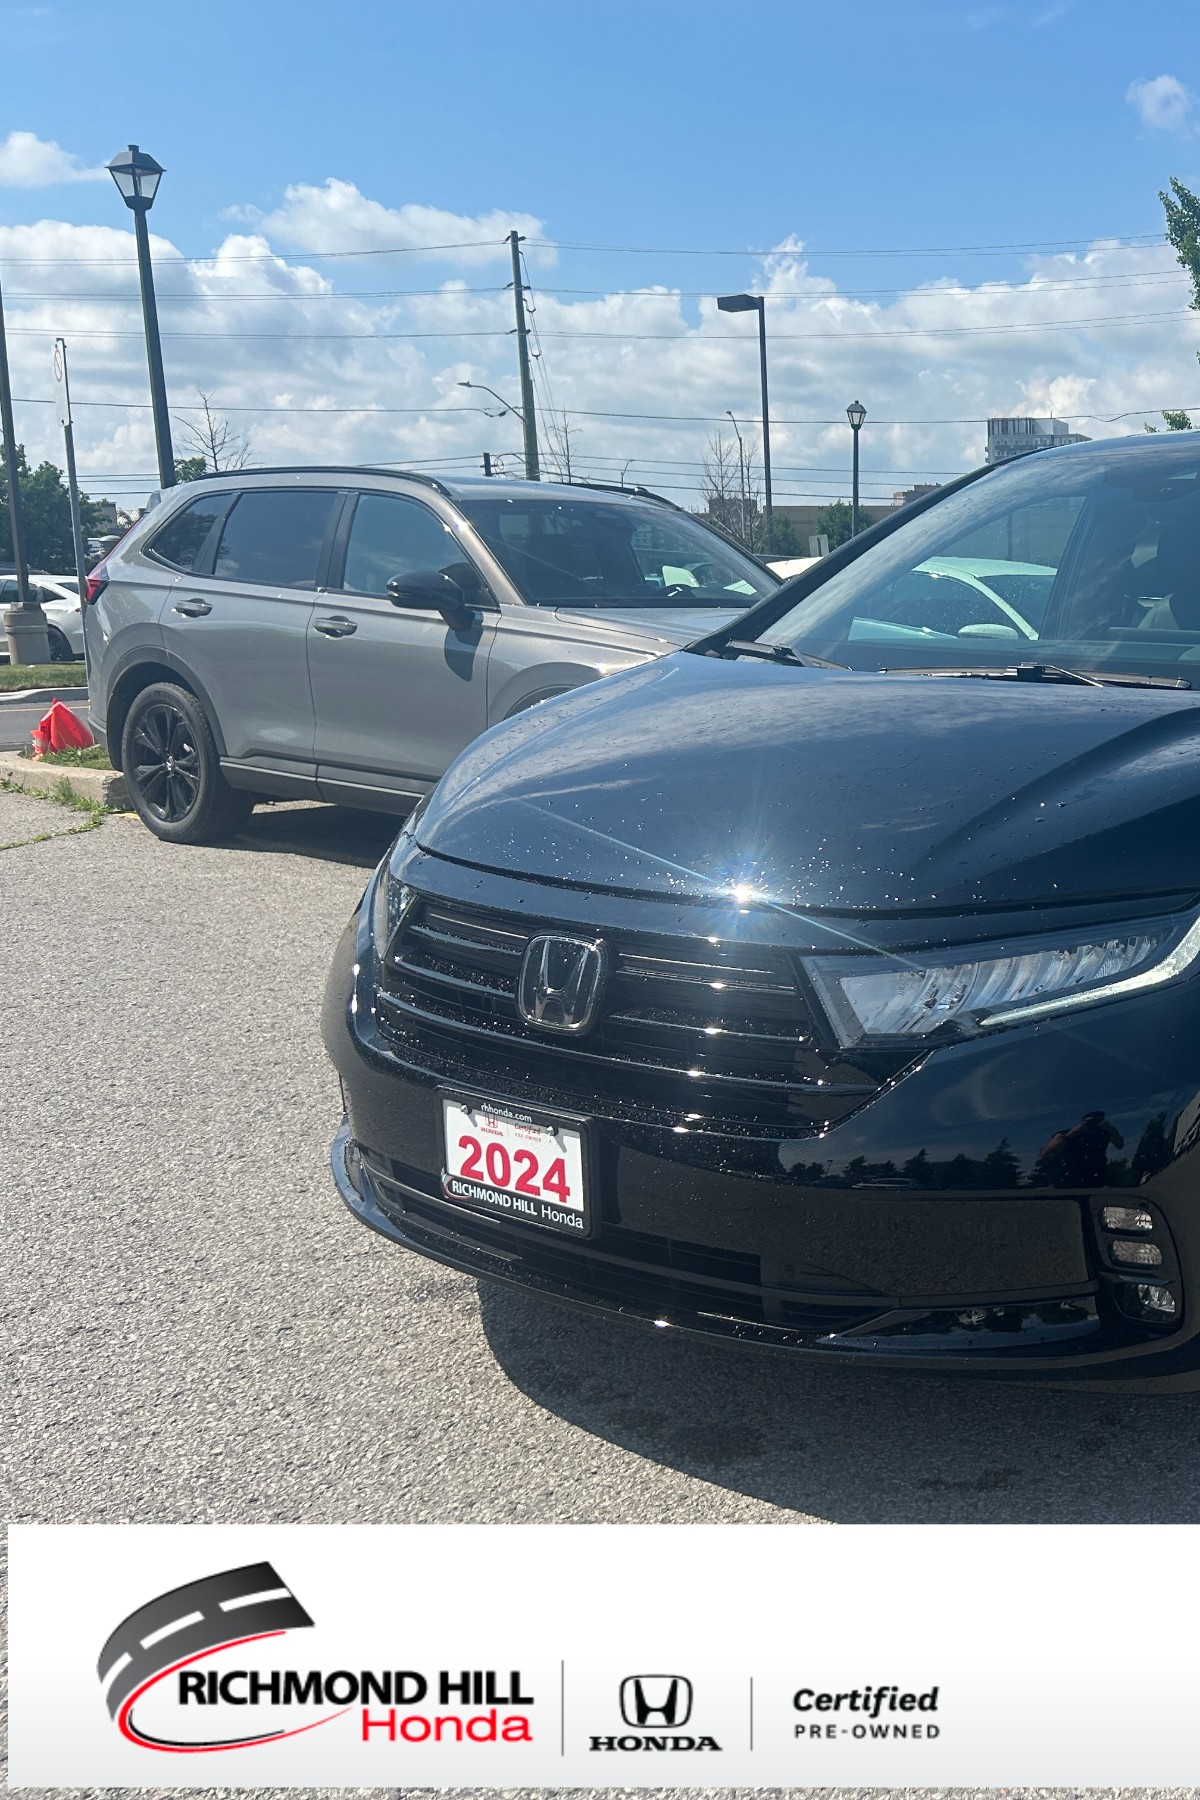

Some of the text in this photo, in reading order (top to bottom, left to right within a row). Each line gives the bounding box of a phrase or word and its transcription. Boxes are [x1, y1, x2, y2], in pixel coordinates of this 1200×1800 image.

[480, 1103, 532, 1123] rhhonda.com
[458, 1135, 571, 1203] 2024
[452, 1180, 584, 1229] RICHMOND HILL Honda
